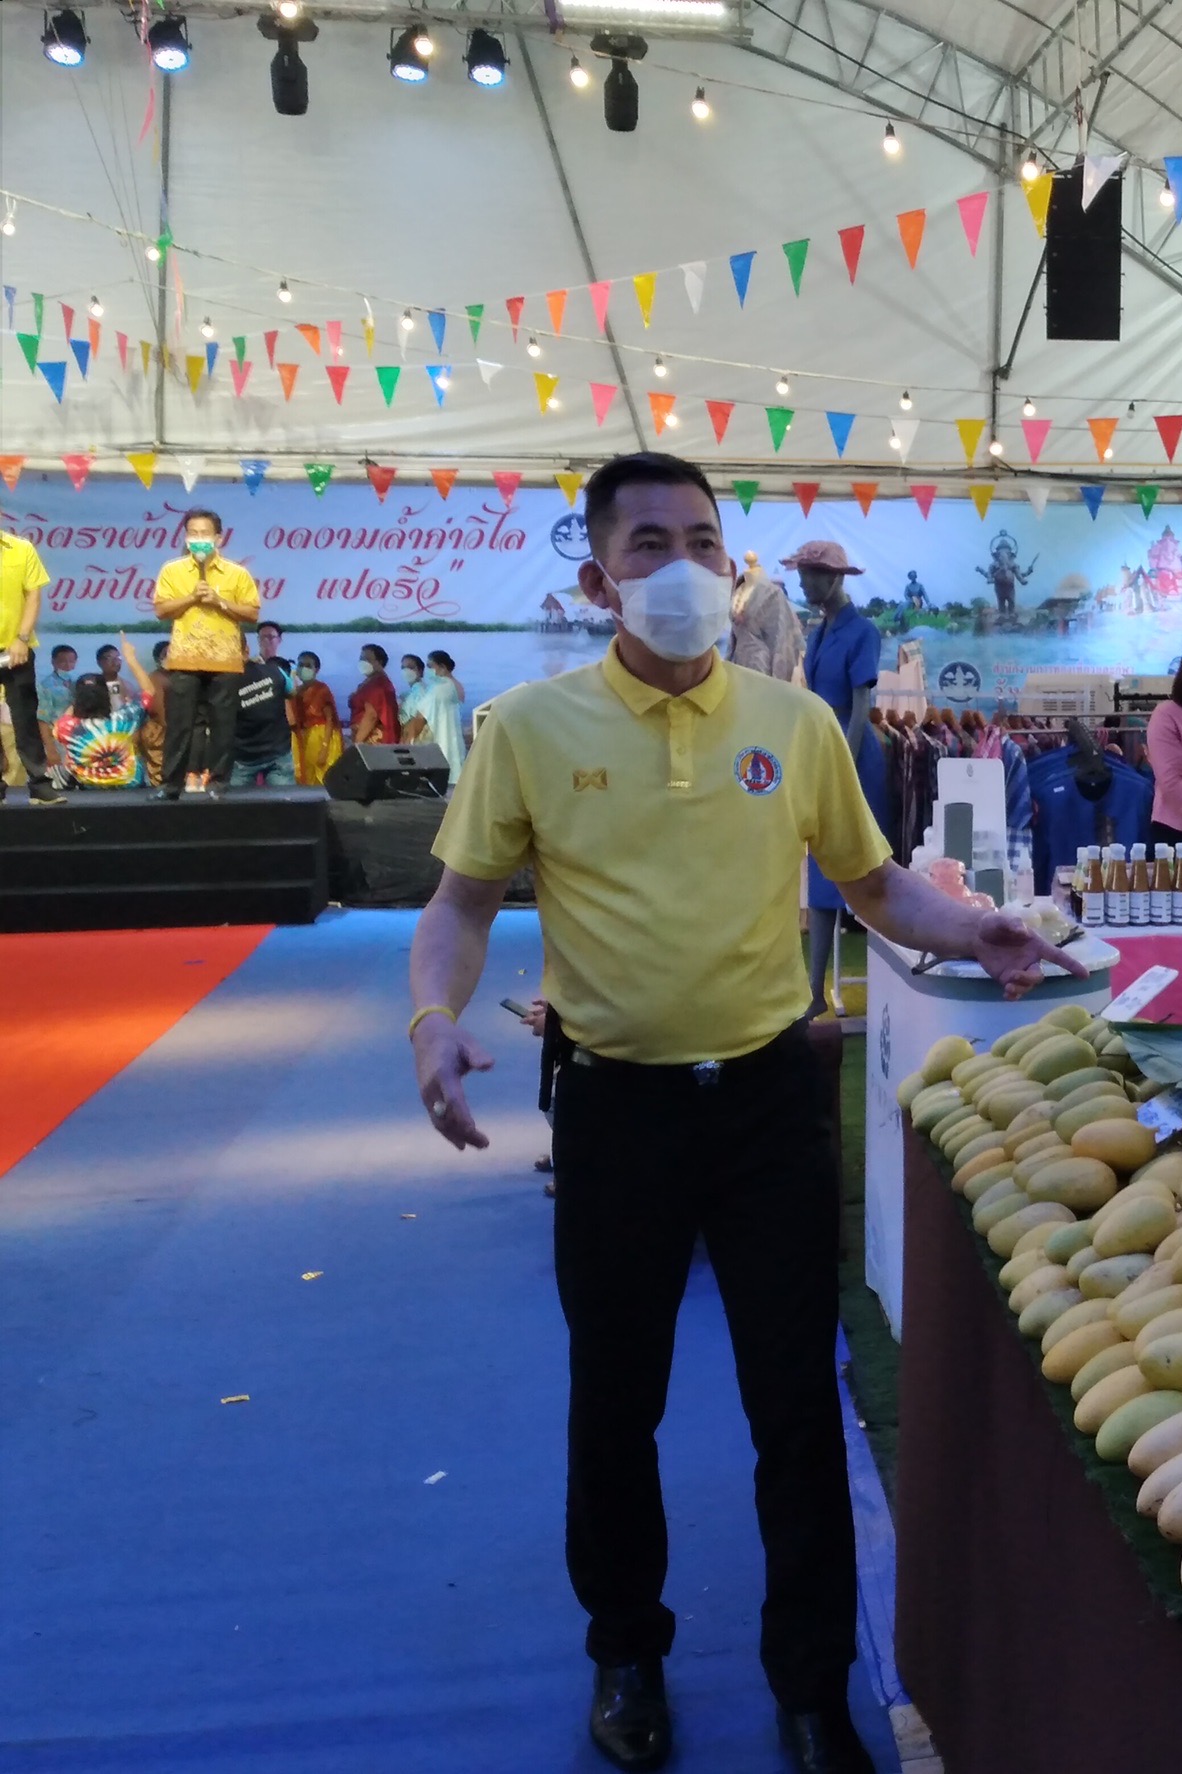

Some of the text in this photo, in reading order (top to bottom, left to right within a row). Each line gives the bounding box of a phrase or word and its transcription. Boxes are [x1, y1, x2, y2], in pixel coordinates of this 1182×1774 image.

[263, 502, 526, 551] งดงามล้ำค่าวิไล
